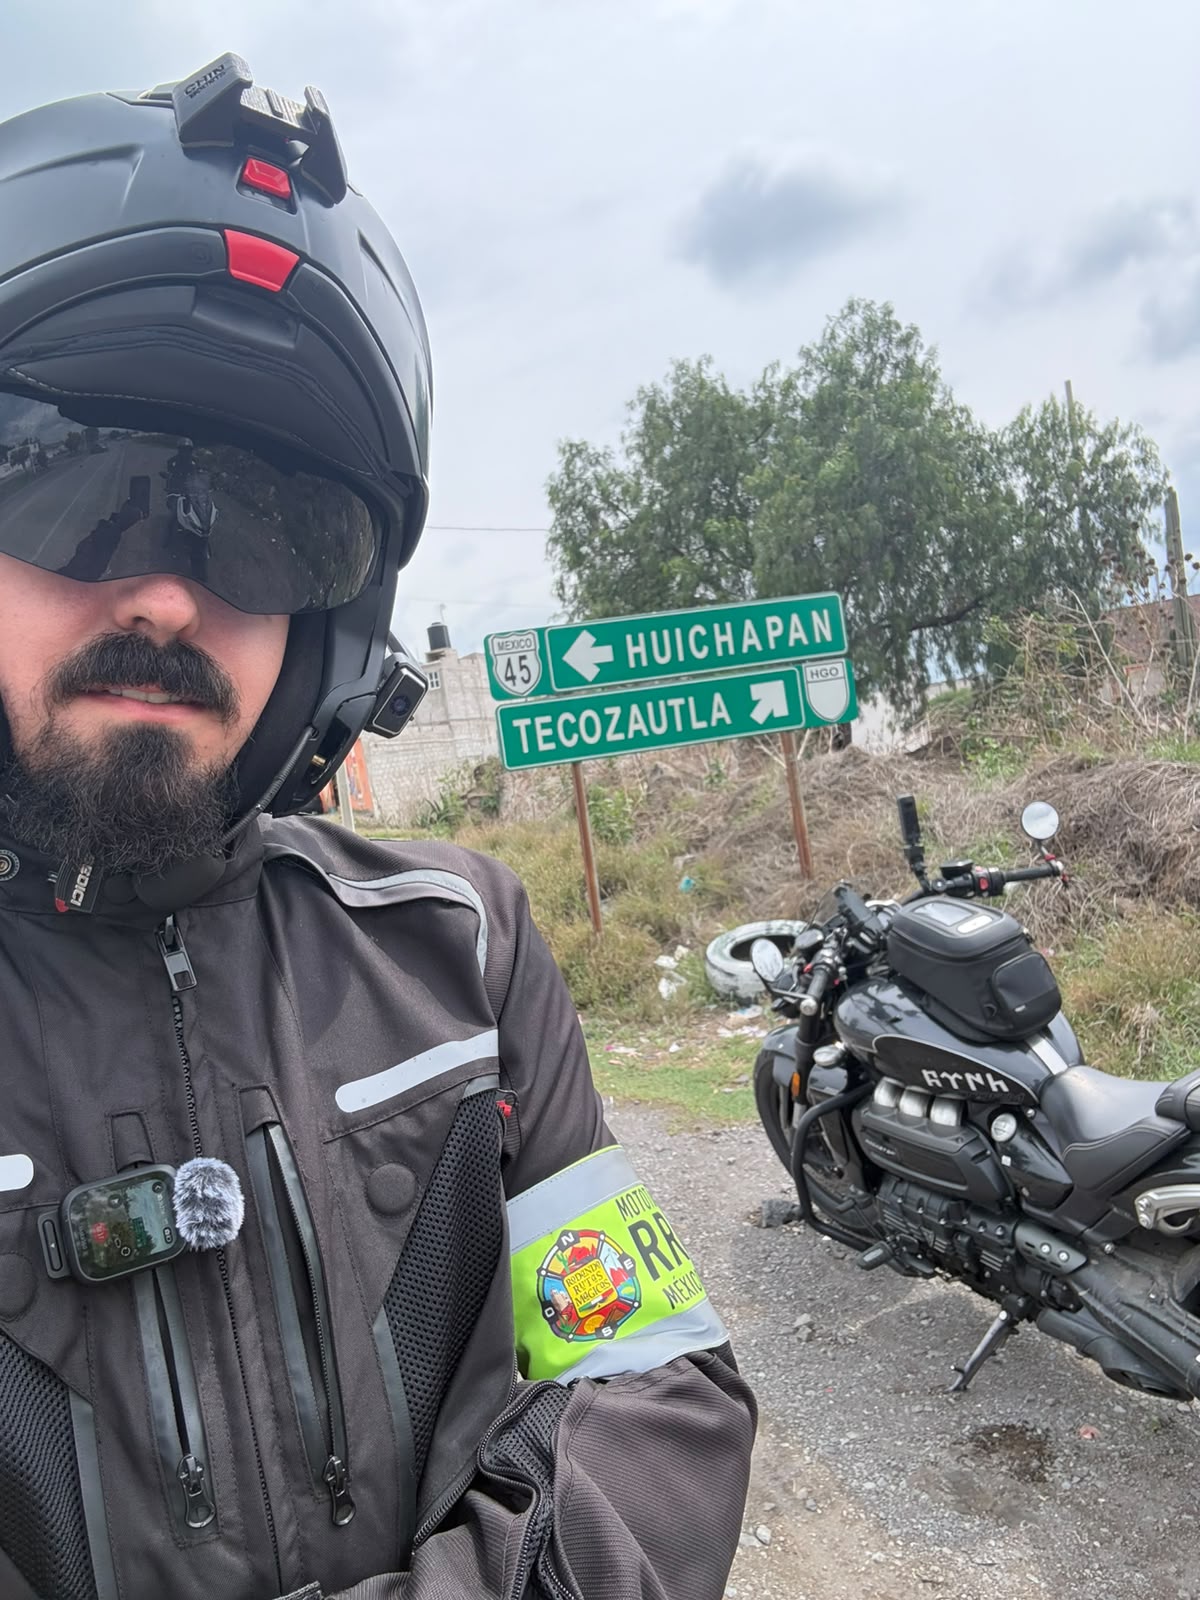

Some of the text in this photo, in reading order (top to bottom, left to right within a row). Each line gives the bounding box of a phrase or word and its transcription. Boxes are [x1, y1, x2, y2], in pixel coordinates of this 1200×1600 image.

[497, 638, 532, 651] MEXICO
[625, 609, 833, 668] HUICHAPAN
[504, 655, 531, 687] 45
[810, 666, 839, 679] HGO
[512, 692, 732, 754] TECOZAUTLA
[561, 1232, 575, 1246] N
[624, 1258, 634, 1270] E
[662, 1270, 703, 1310] MÉXIC
[601, 1326, 613, 1337] S
